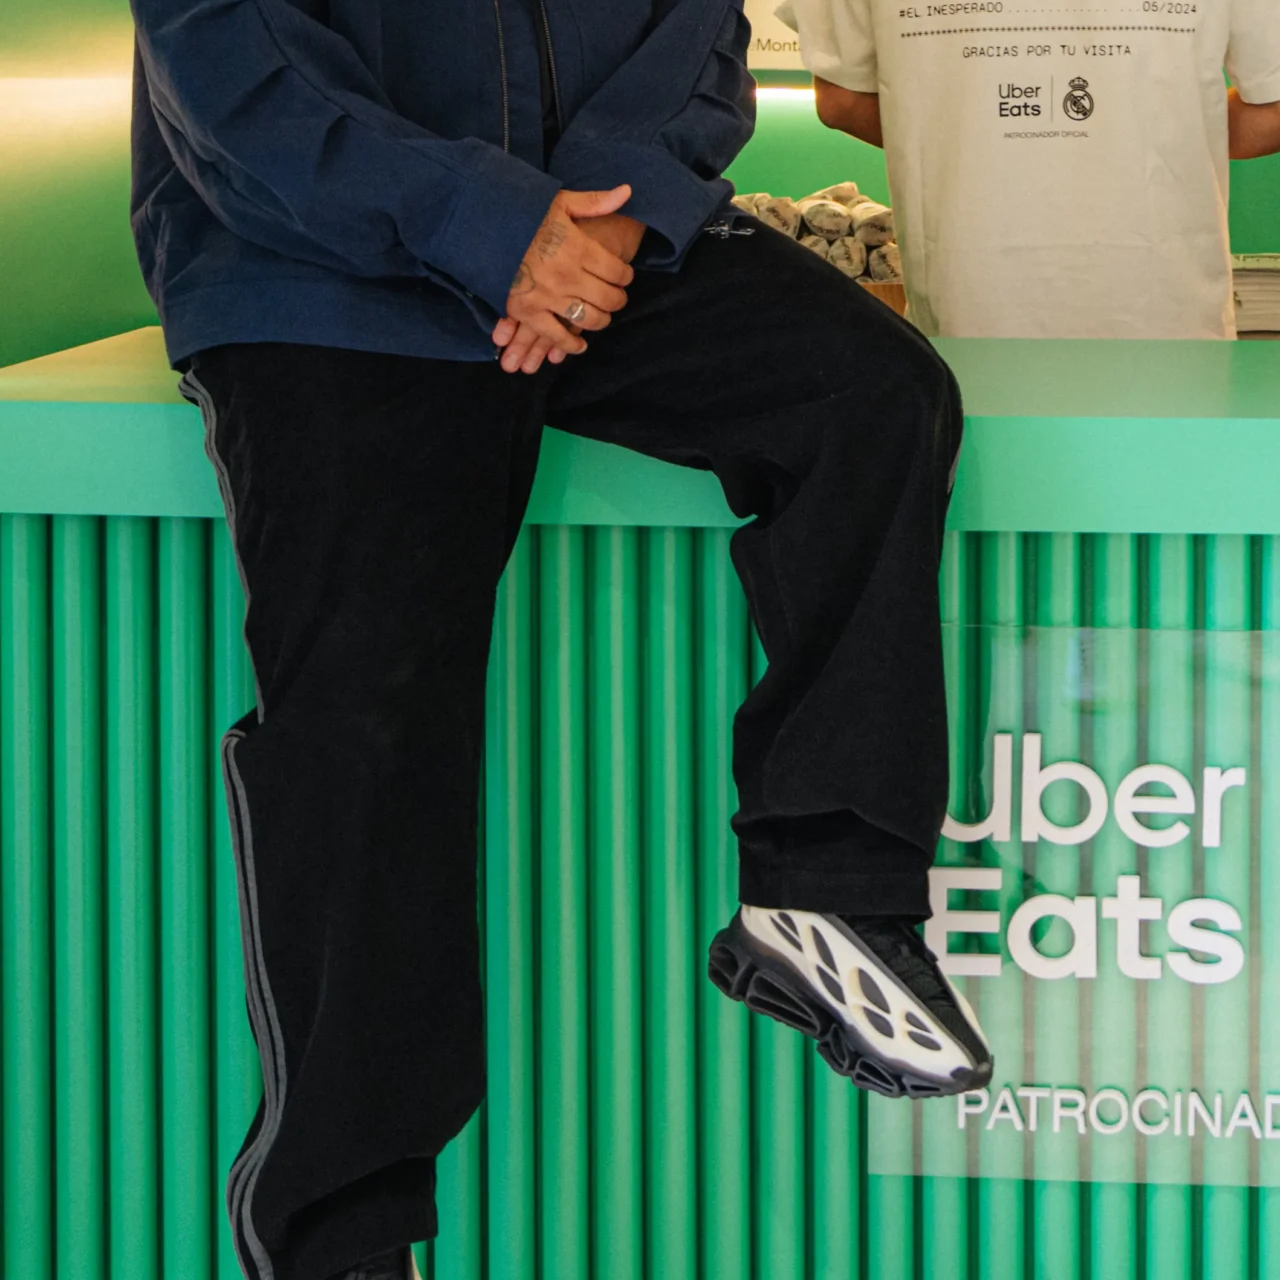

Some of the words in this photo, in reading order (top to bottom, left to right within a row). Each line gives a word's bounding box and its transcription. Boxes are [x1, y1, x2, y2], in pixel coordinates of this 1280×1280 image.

[926, 2, 1004, 17] INESPERADO
[1142, 1, 1197, 14] 05/2024
[962, 45, 1019, 59] GRACIAS
[1027, 45, 1051, 56] POR
[1060, 45, 1076, 56] TU
[1083, 45, 1131, 57] VISITA
[998, 83, 1042, 99] Uber
[998, 102, 1042, 117] Eats
[924, 867, 1245, 984] Eats
